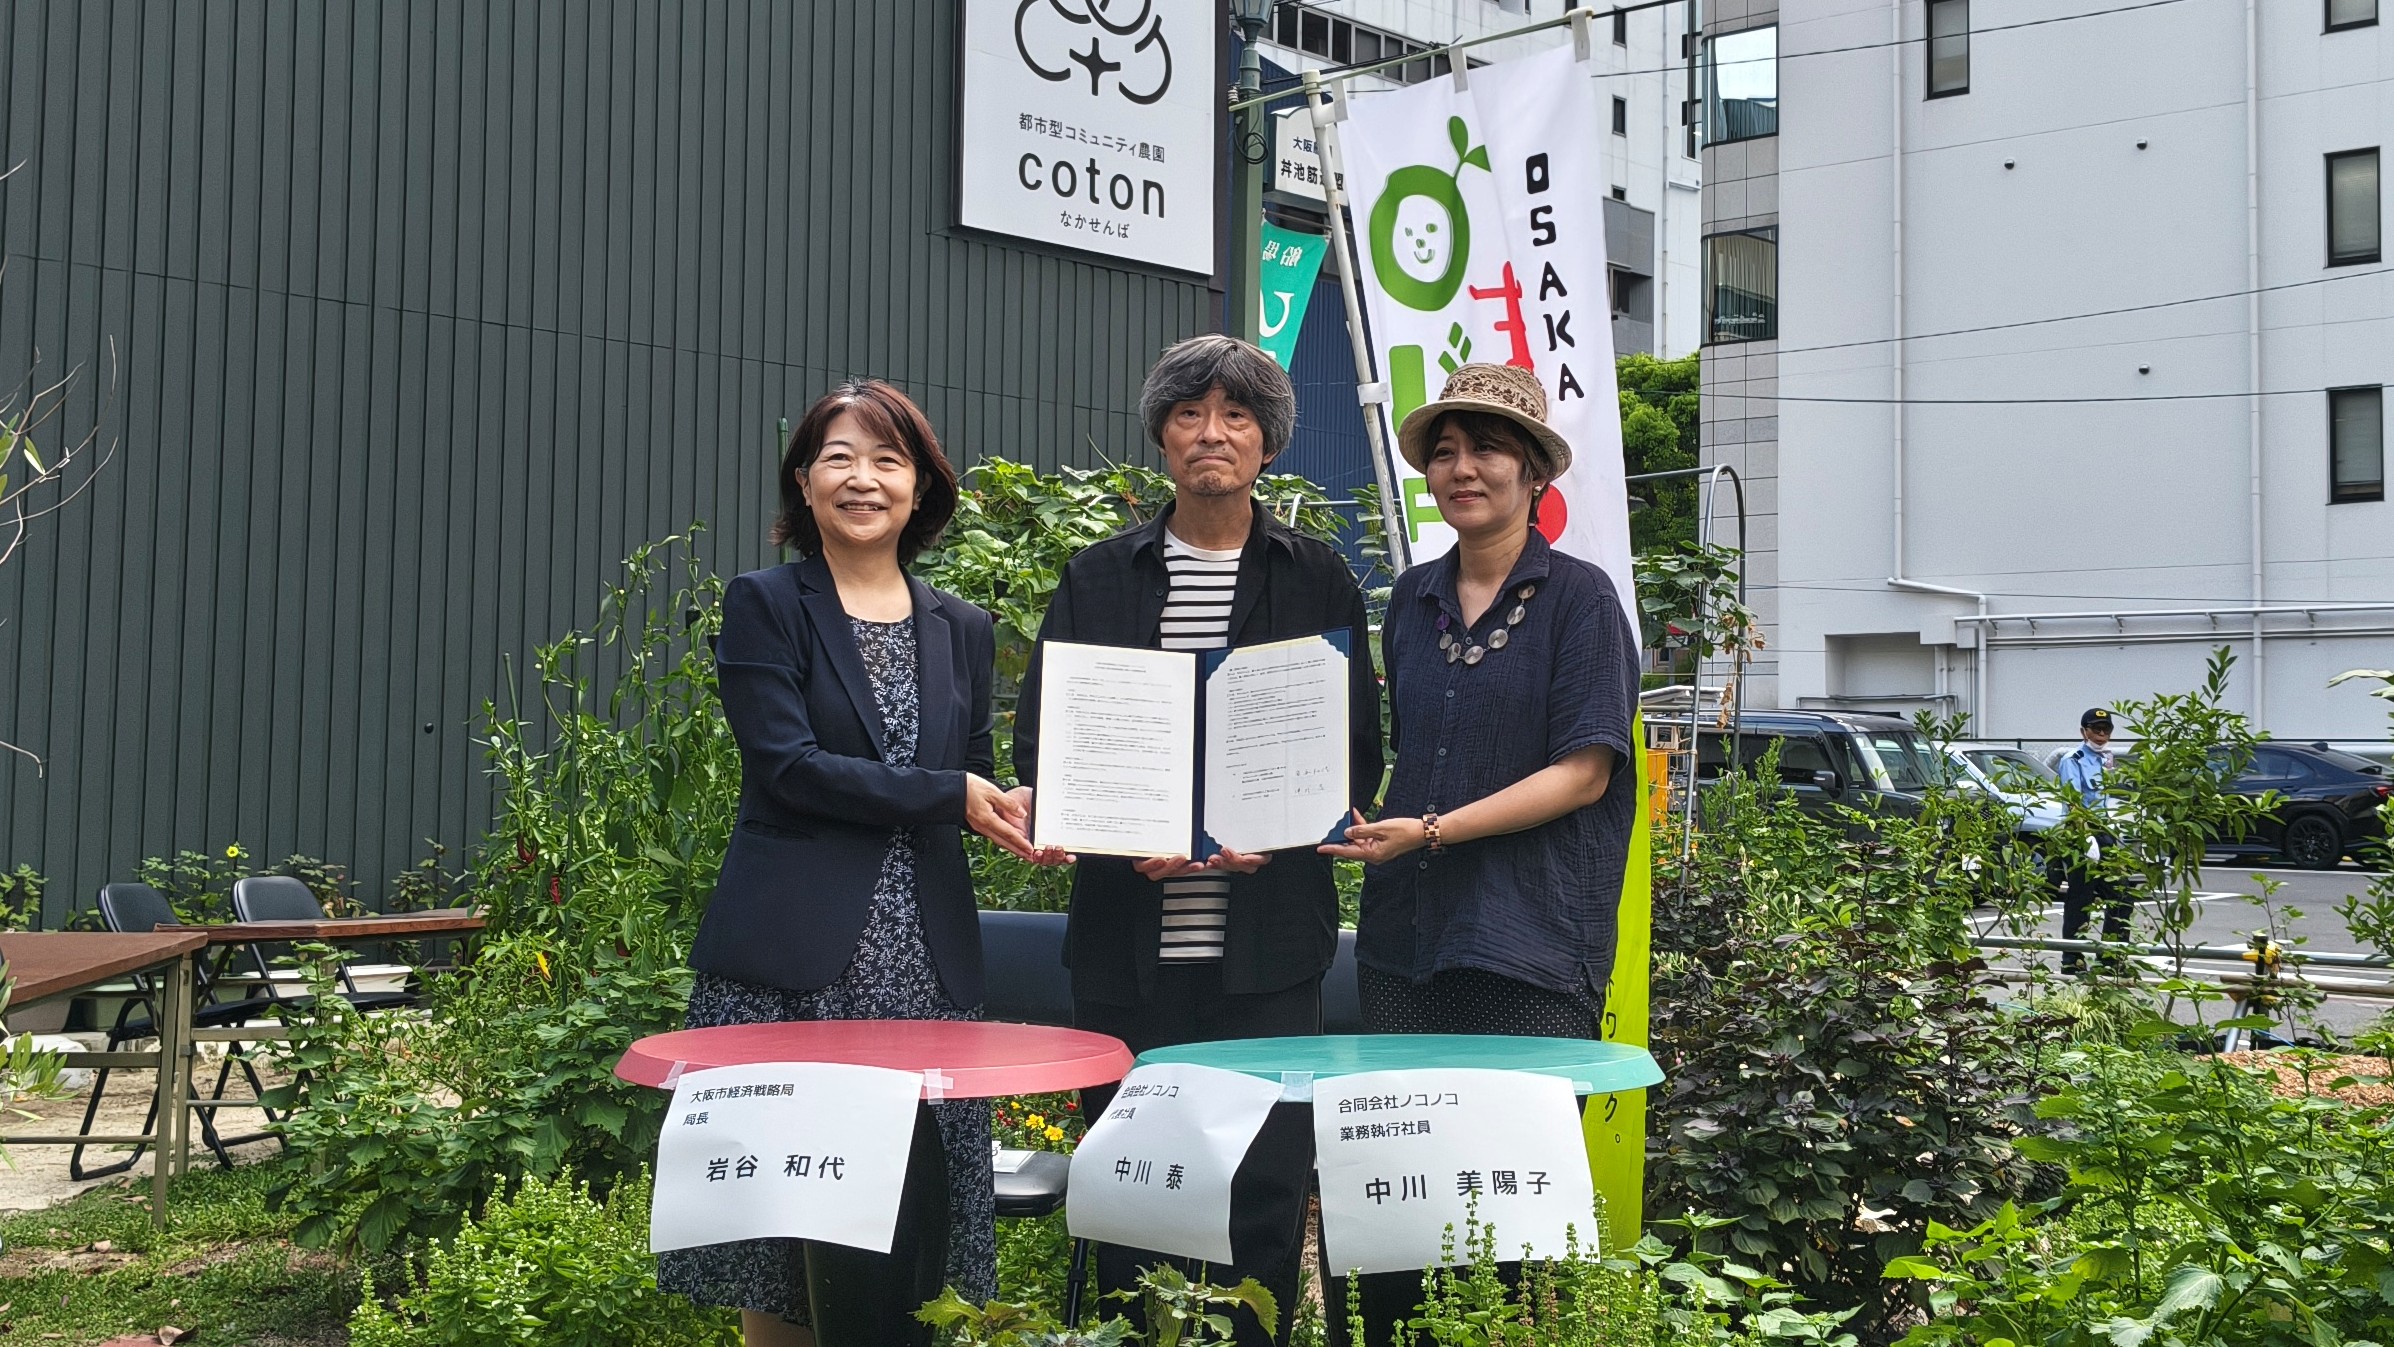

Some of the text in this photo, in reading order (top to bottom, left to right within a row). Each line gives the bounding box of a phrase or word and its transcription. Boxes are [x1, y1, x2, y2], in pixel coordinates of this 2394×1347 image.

[1018, 112, 1166, 164] 都市型コミュニティ農園
[1018, 152, 1165, 219] coton
[1059, 210, 1131, 240] なかせんば
[1525, 151, 1585, 402] OSAKA
[690, 1083, 795, 1103] 大阪市経済戦略局
[1338, 1092, 1459, 1114] 合同会社ノコノコ
[683, 1111, 709, 1126] 局長
[1340, 1119, 1431, 1142] 業務執行社員
[706, 1154, 846, 1183] 岩谷 和代
[1114, 1156, 1185, 1191] 中川 泰
[1365, 1169, 1551, 1205] 中川 美陽子
